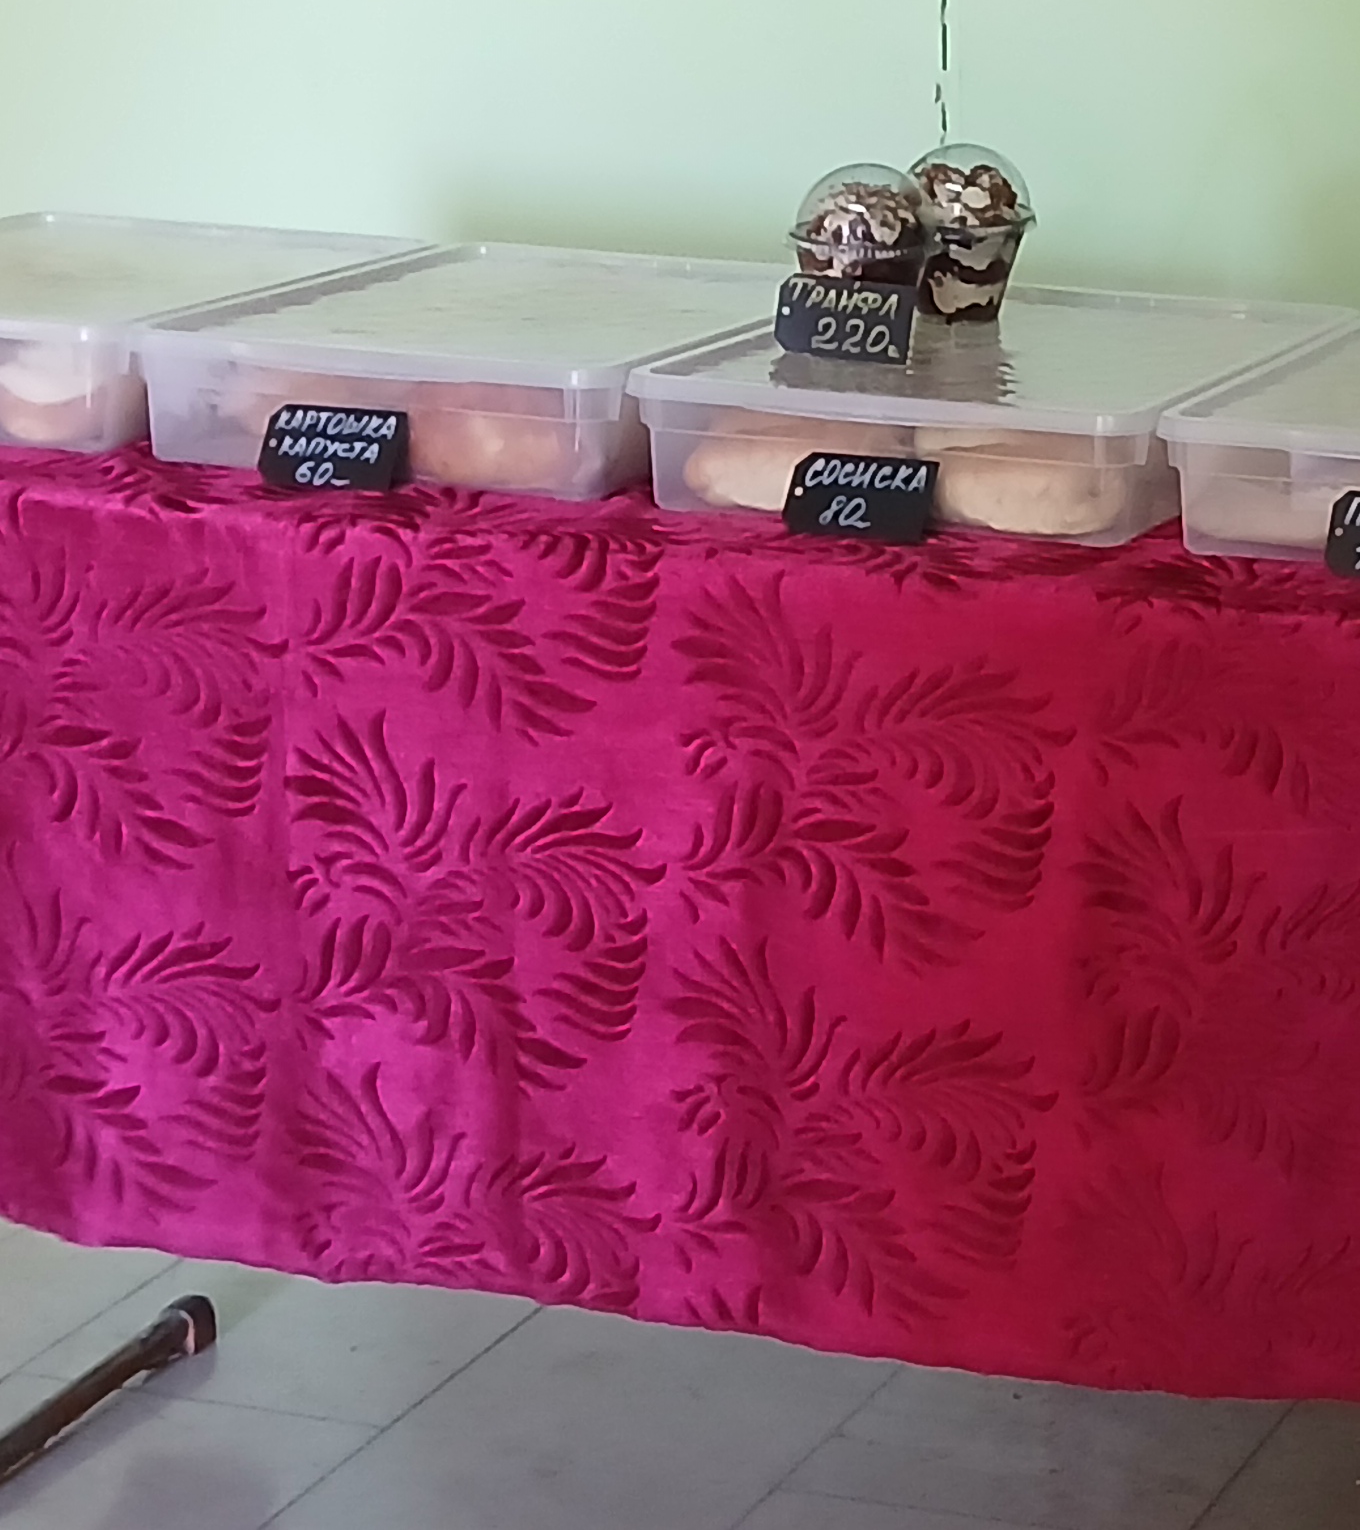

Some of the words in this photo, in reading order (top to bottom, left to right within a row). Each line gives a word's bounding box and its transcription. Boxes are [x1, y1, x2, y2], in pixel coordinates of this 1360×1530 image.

[274, 408, 398, 441] КАРТОШКА
[277, 434, 381, 465] КАПУСТА
[804, 457, 928, 493] СОСИСКА
